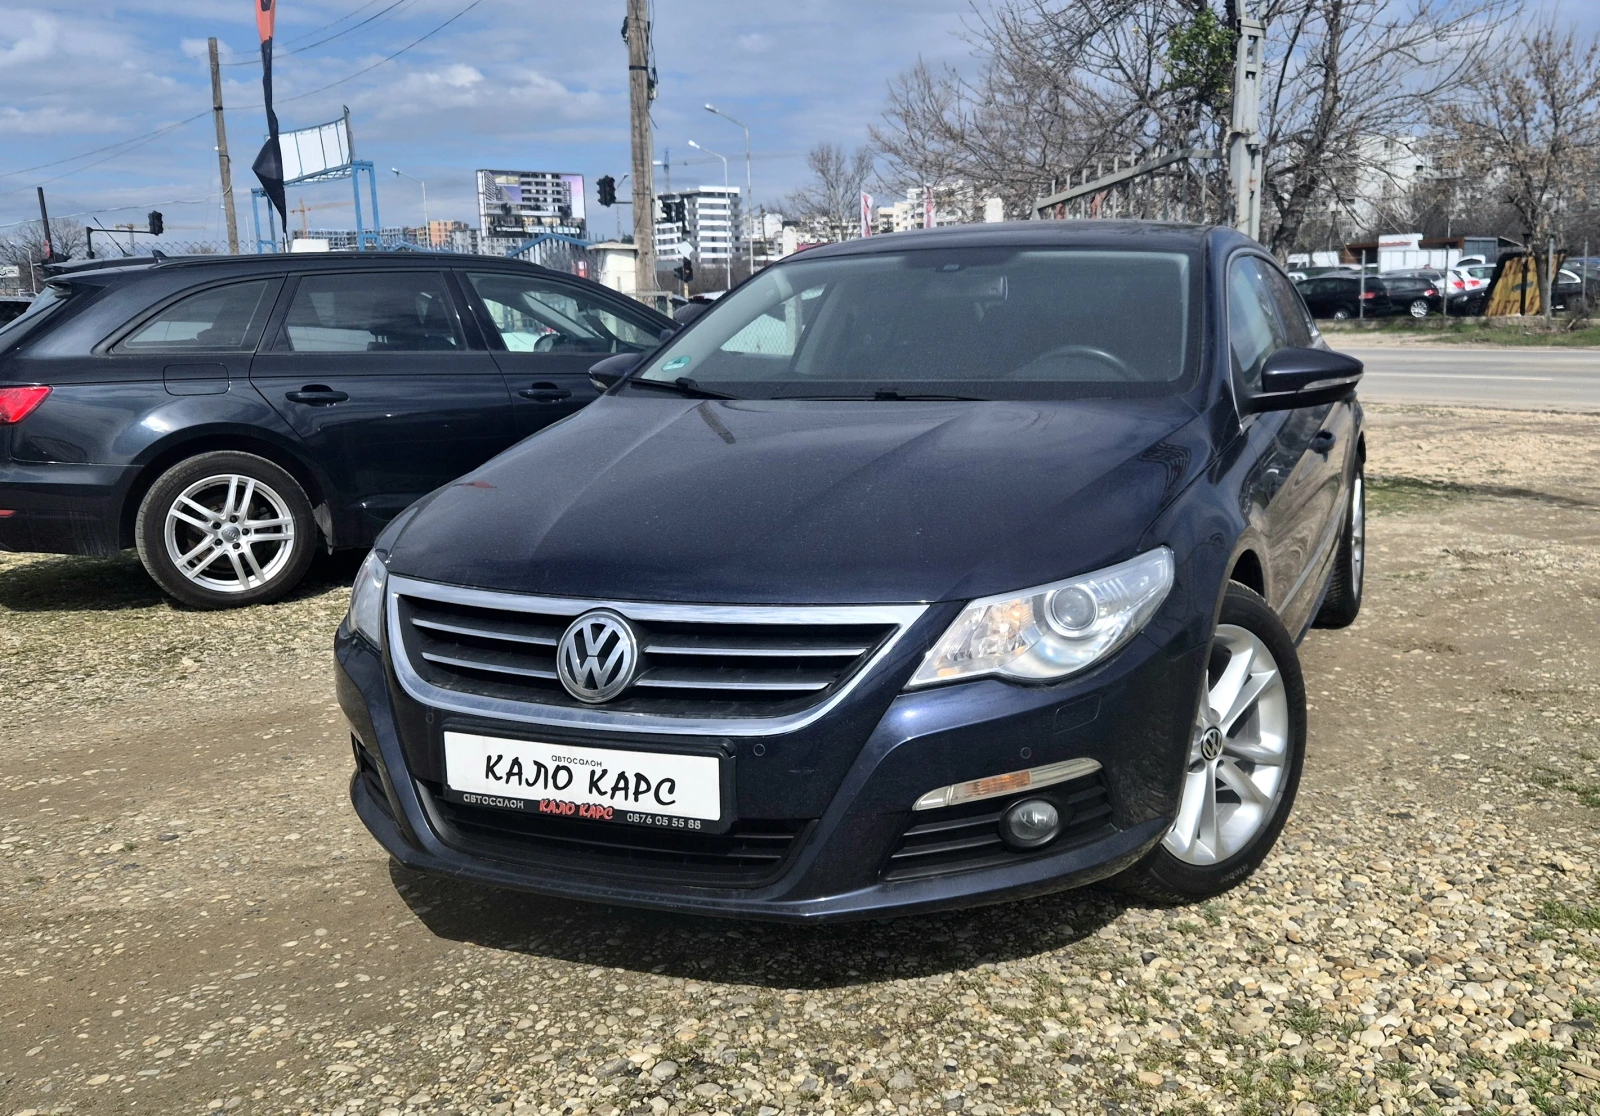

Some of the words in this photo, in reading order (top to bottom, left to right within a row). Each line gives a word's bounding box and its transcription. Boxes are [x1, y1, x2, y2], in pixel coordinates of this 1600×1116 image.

[551, 754, 603, 768] автосалон
[485, 754, 574, 791] КАЛО
[588, 768, 676, 806] КАРС
[463, 793, 524, 810] автосалон
[538, 798, 576, 816] КАЛО
[578, 801, 614, 820] КАРС
[626, 812, 653, 825] 0876
[655, 815, 669, 827] 05
[671, 817, 685, 828] 55
[687, 818, 702, 830] 88
